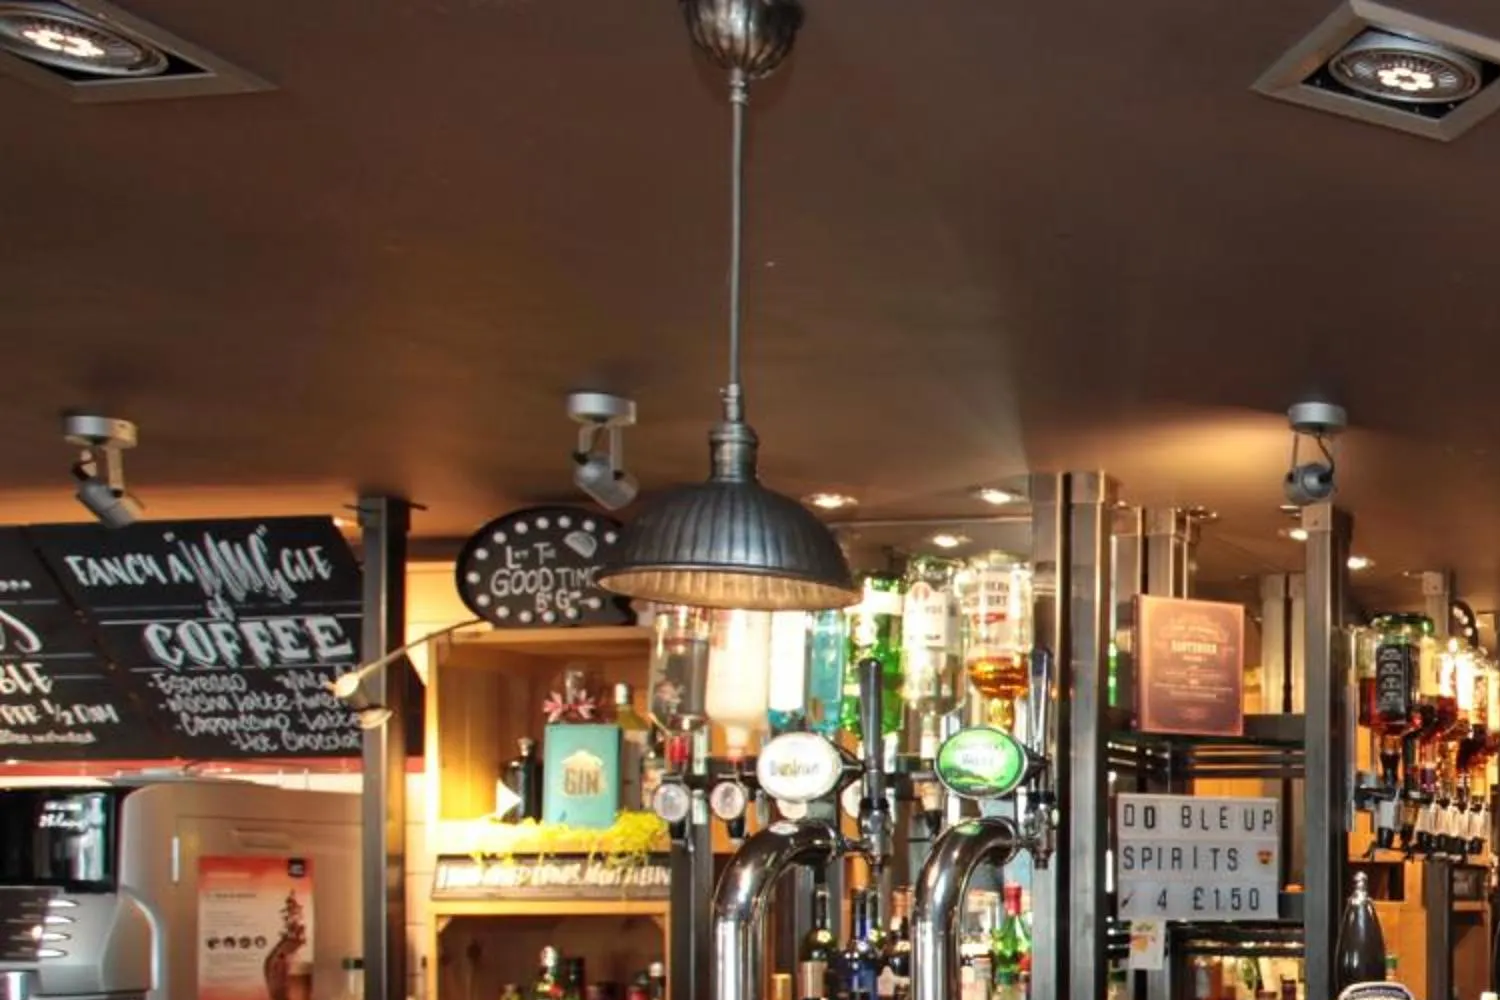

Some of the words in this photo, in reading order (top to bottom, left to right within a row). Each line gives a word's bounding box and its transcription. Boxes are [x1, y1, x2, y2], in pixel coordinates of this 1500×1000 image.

[64, 553, 166, 586] FANCY
[490, 567, 554, 596] GOOD
[143, 615, 353, 671] COFFEE
[564, 768, 600, 796] GIN
[1123, 846, 1239, 871] SPIRITS
[1157, 888, 1168, 910] 4
